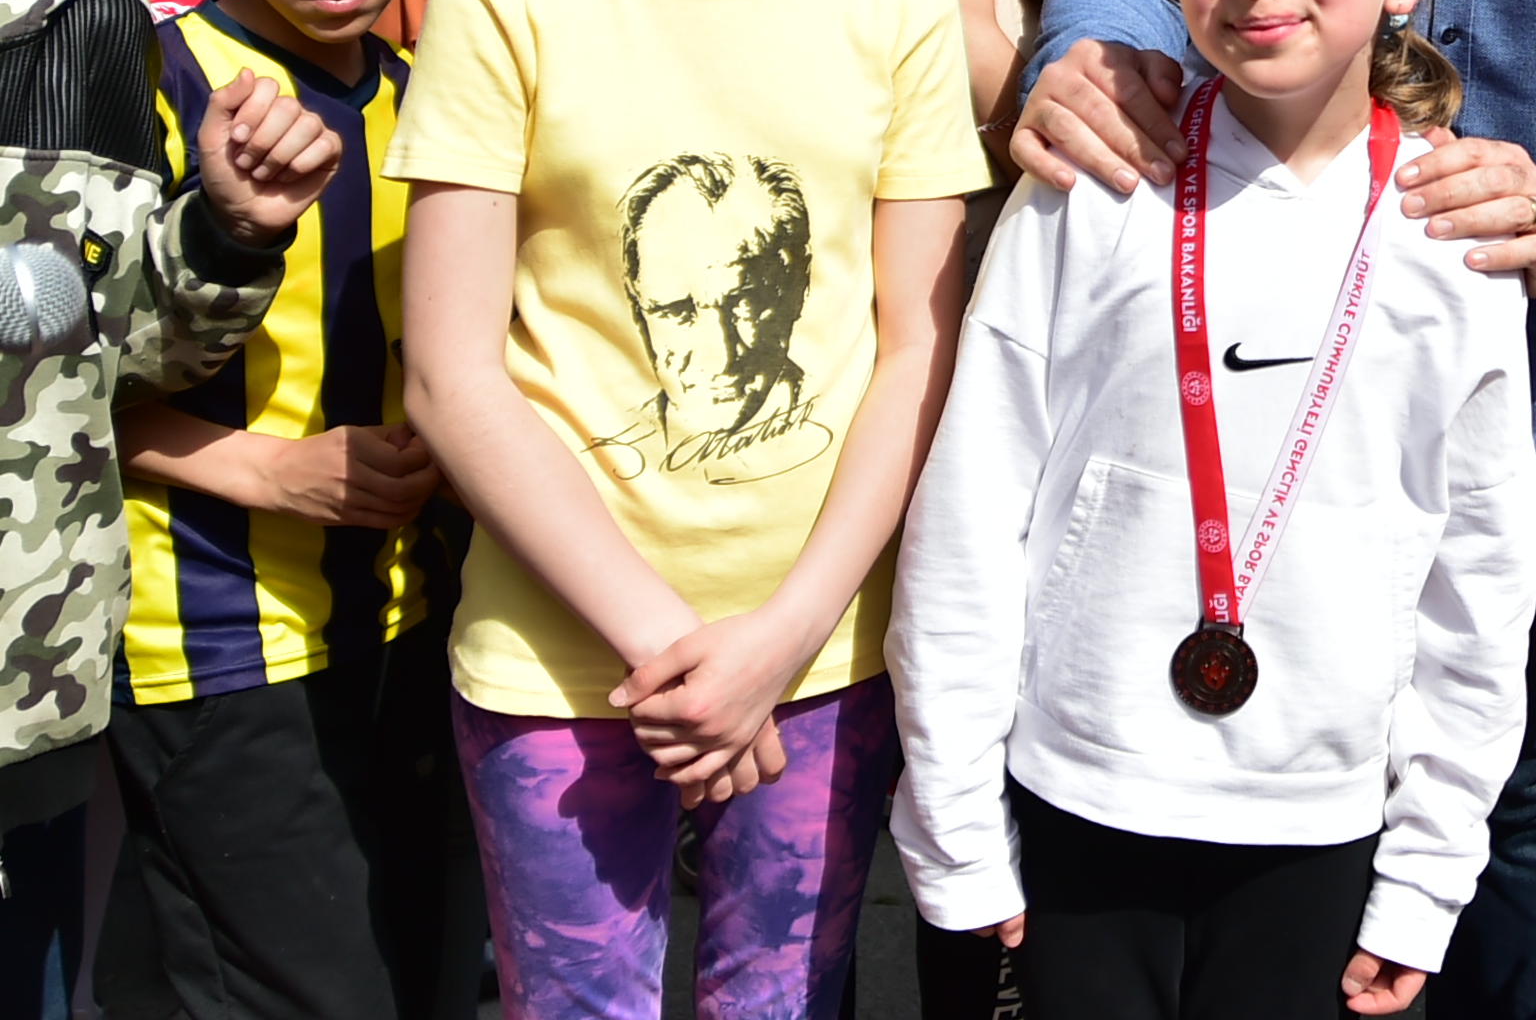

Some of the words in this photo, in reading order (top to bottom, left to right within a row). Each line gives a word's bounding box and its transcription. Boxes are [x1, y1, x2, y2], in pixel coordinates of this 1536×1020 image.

[1183, 174, 1198, 194] VE
[1181, 198, 1197, 238] SPOR
[1180, 242, 1202, 333] BAKANLIĞI
